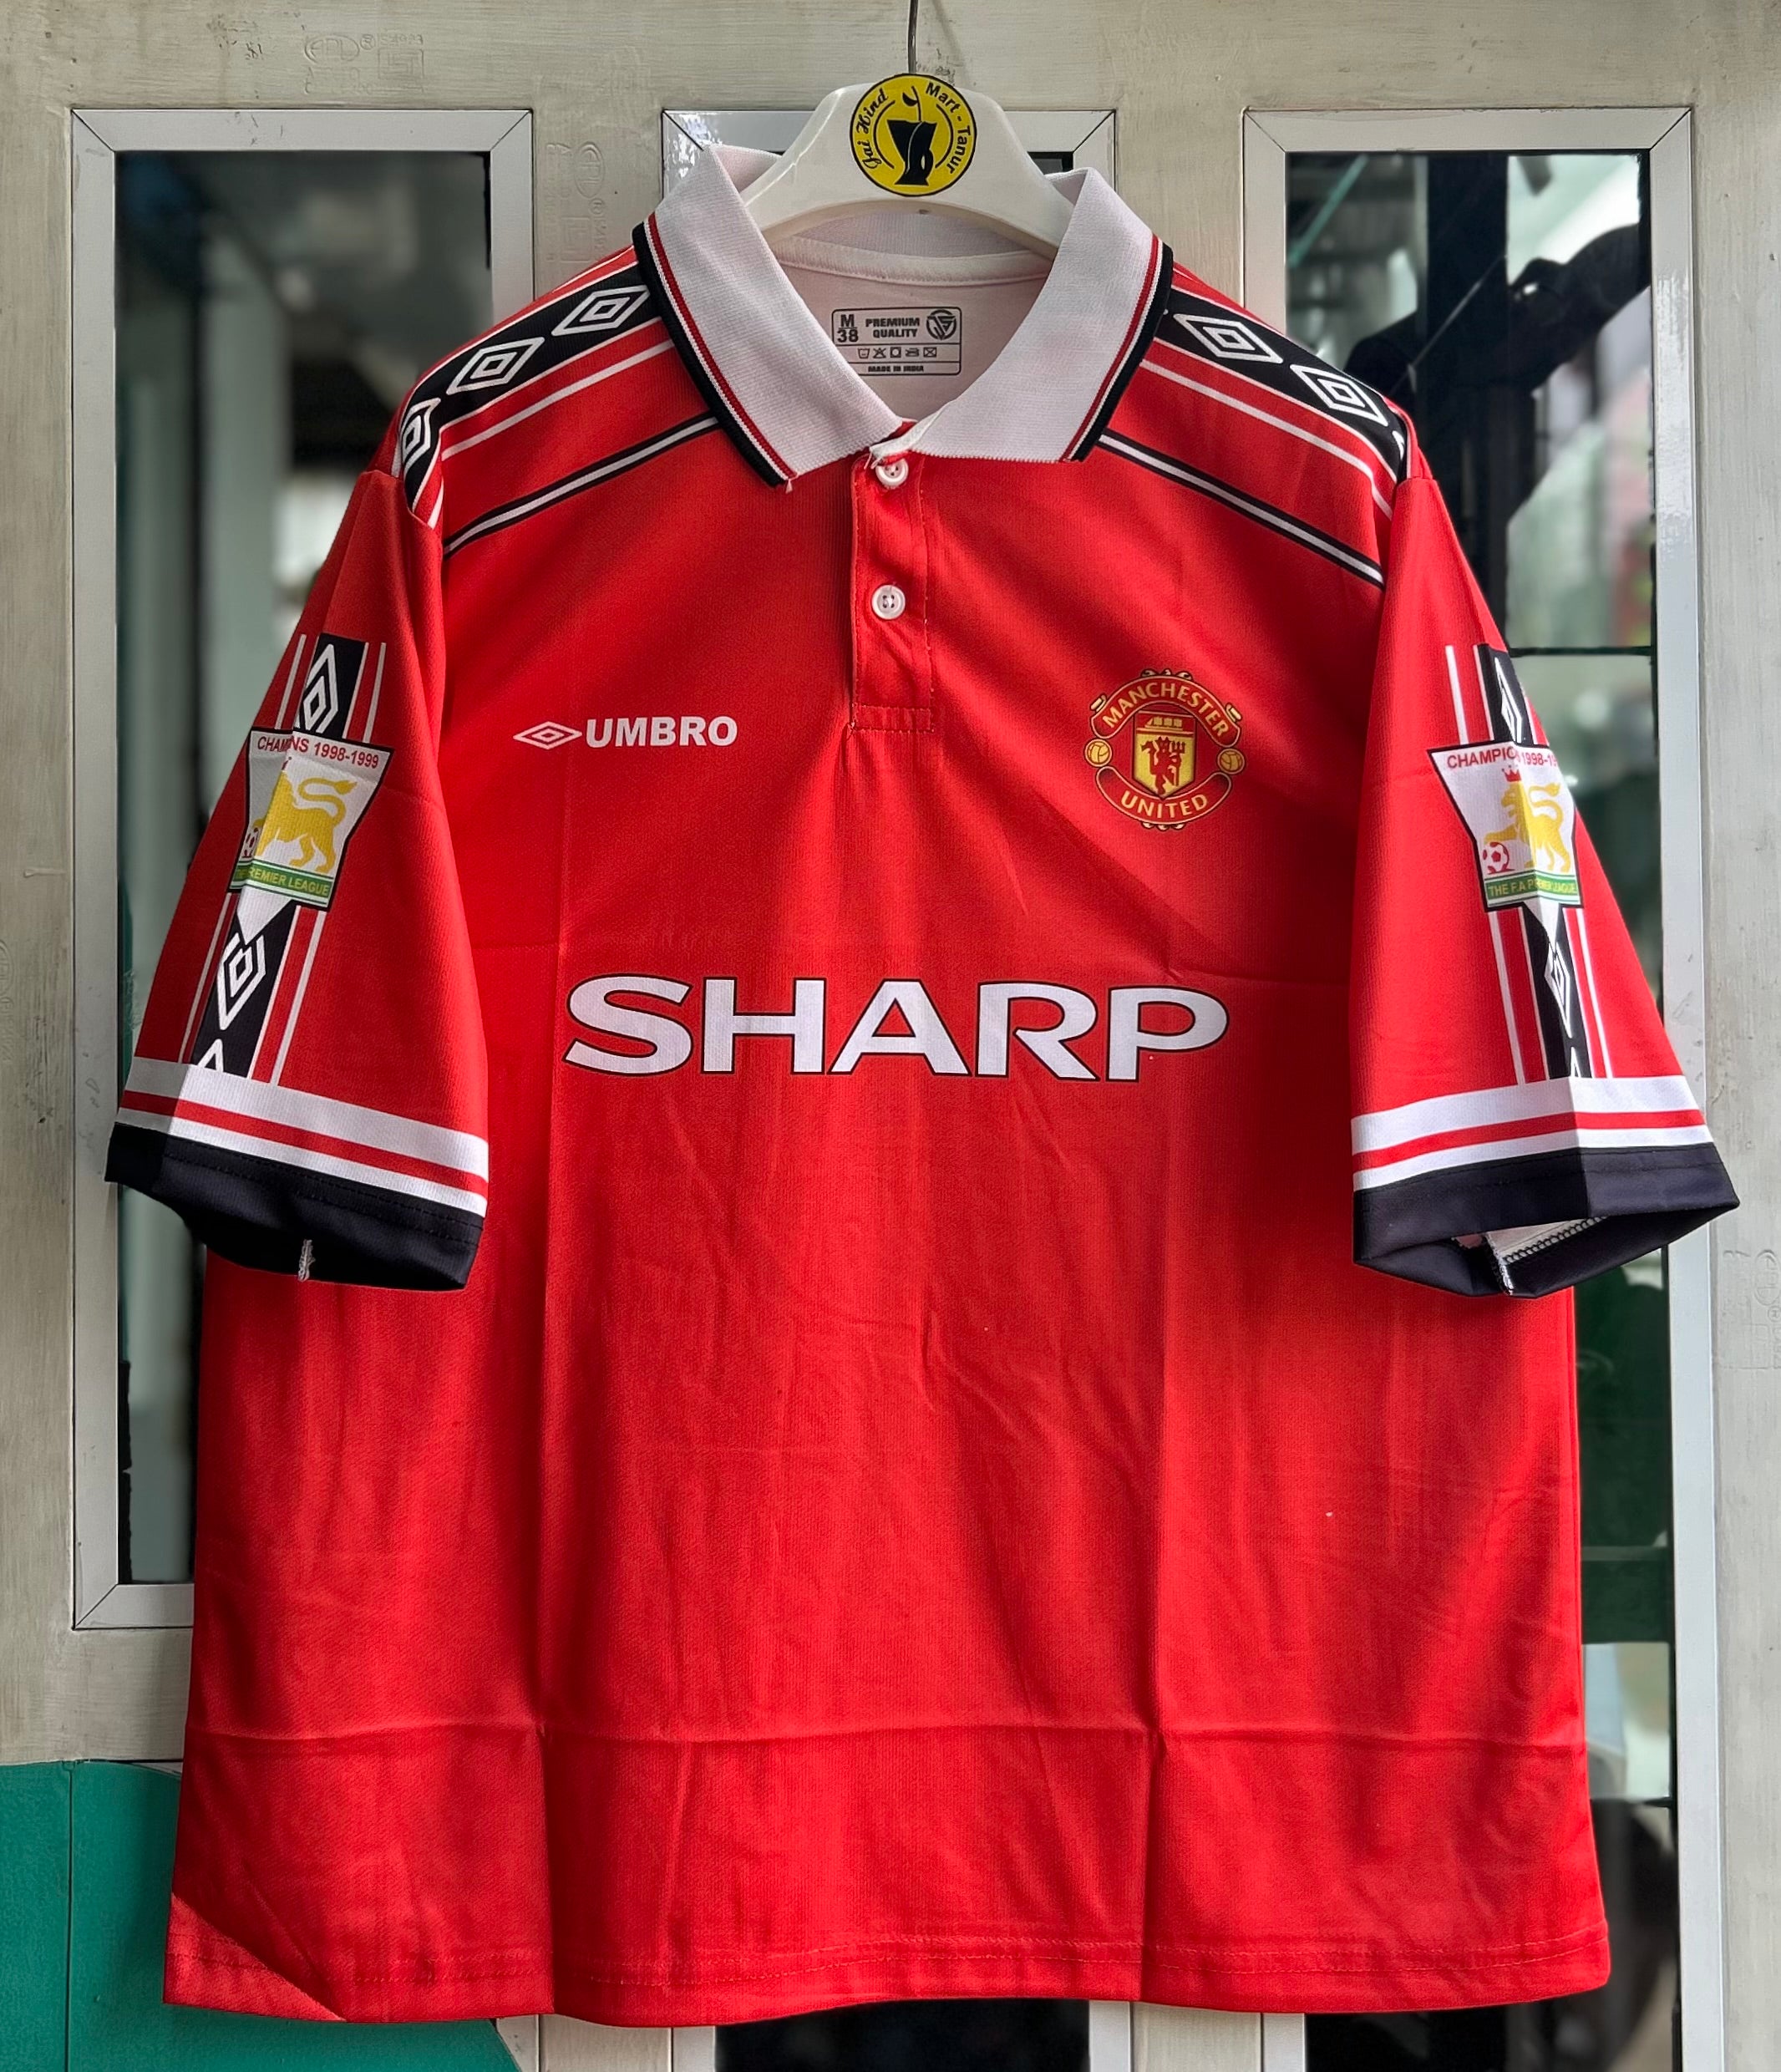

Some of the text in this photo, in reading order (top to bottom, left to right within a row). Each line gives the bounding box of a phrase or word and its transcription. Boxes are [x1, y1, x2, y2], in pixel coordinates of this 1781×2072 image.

[855, 88, 889, 135] Hind
[925, 82, 961, 114] Mart
[856, 140, 883, 170] Jai
[946, 125, 972, 175] Tanur
[837, 329, 859, 343] 38
[840, 314, 855, 328] M
[865, 317, 921, 328] PREMIUM
[872, 328, 918, 338] QUALITY
[1102, 682, 1230, 737] MANCHESTER
[586, 716, 738, 749] UMBRO
[314, 741, 380, 769] 1998-1999
[1120, 790, 1208, 819] UNITED
[248, 866, 287, 886] REMIER
[288, 876, 331, 896] LEAGUE
[1488, 883, 1510, 896] THE
[563, 973, 1230, 1083] SHARP
